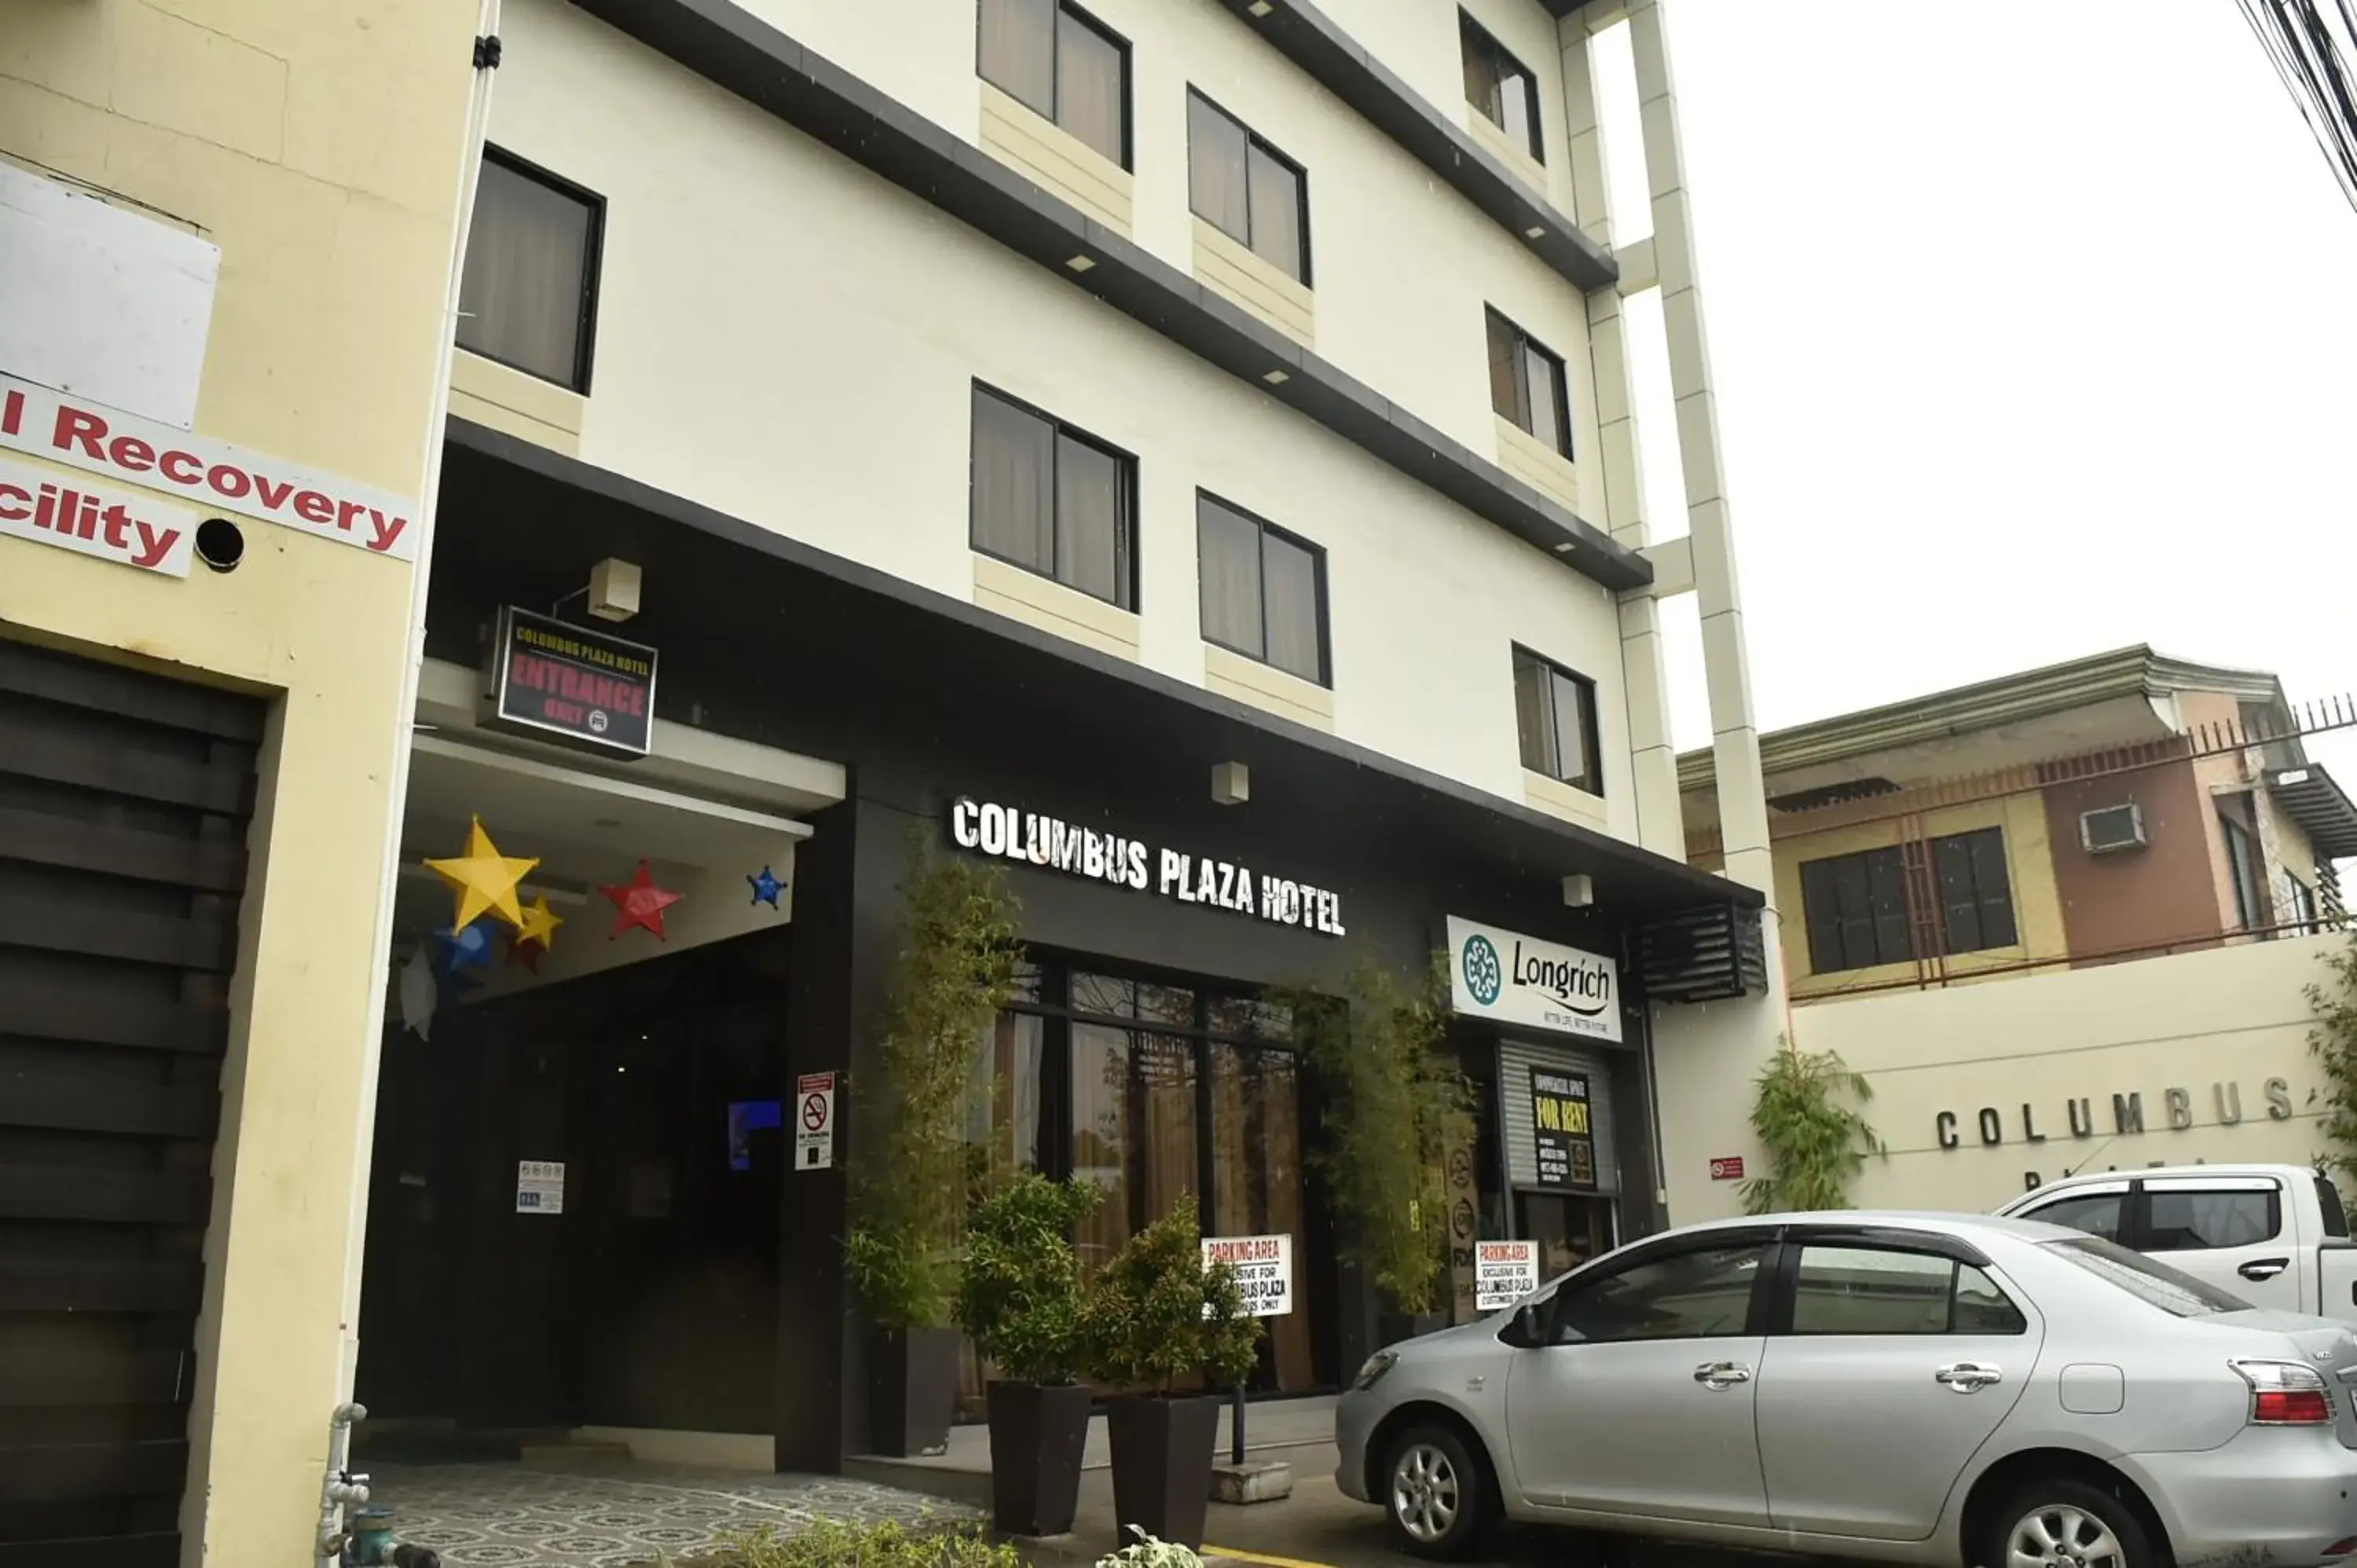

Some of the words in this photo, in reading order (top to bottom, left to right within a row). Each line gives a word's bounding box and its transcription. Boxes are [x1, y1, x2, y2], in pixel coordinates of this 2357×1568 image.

[53, 404, 408, 552] Recovery
[516, 626, 579, 656] COLUMBUS
[581, 645, 614, 666] PLAZA
[617, 656, 649, 676] HOTEL
[510, 653, 645, 717] ENTRANCE
[544, 698, 585, 726] ONLY
[953, 798, 1148, 890] COLUMBUS
[1160, 848, 1255, 914] PLAZA
[1261, 875, 1346, 936] HOTEL
[1513, 940, 1609, 1000] Longrich
[1536, 1097, 1560, 1130] FOR
[1561, 1101, 1589, 1134] RENT
[1936, 1076, 2293, 1151] COLUMBUS
[1208, 1240, 1253, 1263] PARKING
[1253, 1240, 1280, 1260] AREA
[1480, 1244, 1511, 1262] PARKING
[1511, 1244, 1529, 1260] AREA
[1259, 1267, 1277, 1279] FOR
[1476, 1279, 1514, 1295] COLUMBUS
[1514, 1277, 1533, 1292] PLAZA
[1483, 1267, 1513, 1278] EXCLUSIVE
[1516, 1266, 1527, 1277] FOR
[1260, 1280, 1286, 1298] PLAZA
[1261, 1299, 1280, 1311] ONLY
